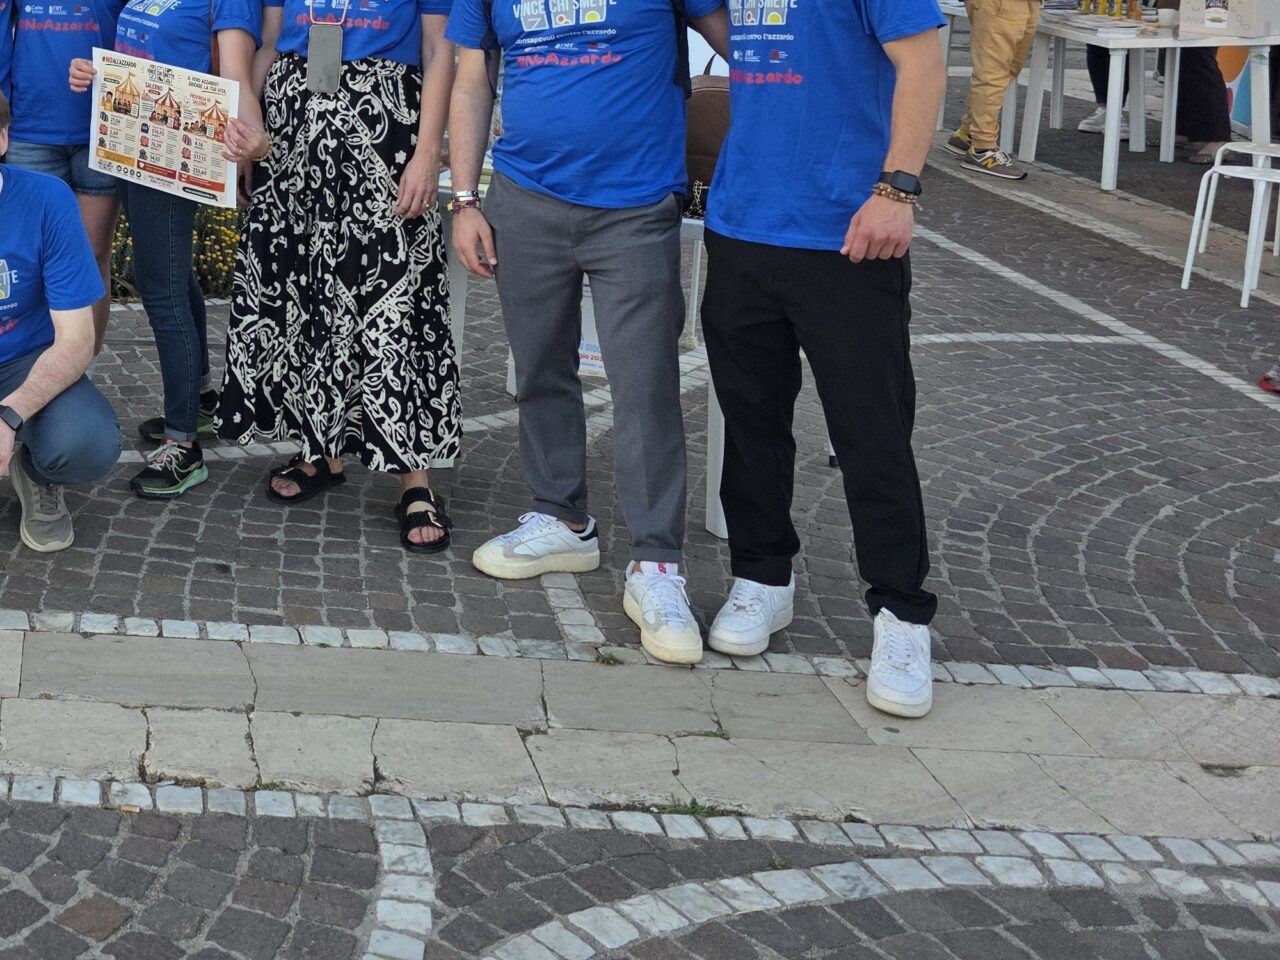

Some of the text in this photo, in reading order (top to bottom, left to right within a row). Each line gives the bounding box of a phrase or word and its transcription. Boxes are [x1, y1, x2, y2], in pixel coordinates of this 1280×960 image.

[513, 0, 545, 18] VINCE
[516, 35, 555, 44] consapevoli
[517, 51, 622, 68] #NoAzzardo
[145, 82, 163, 91] SALERNO
